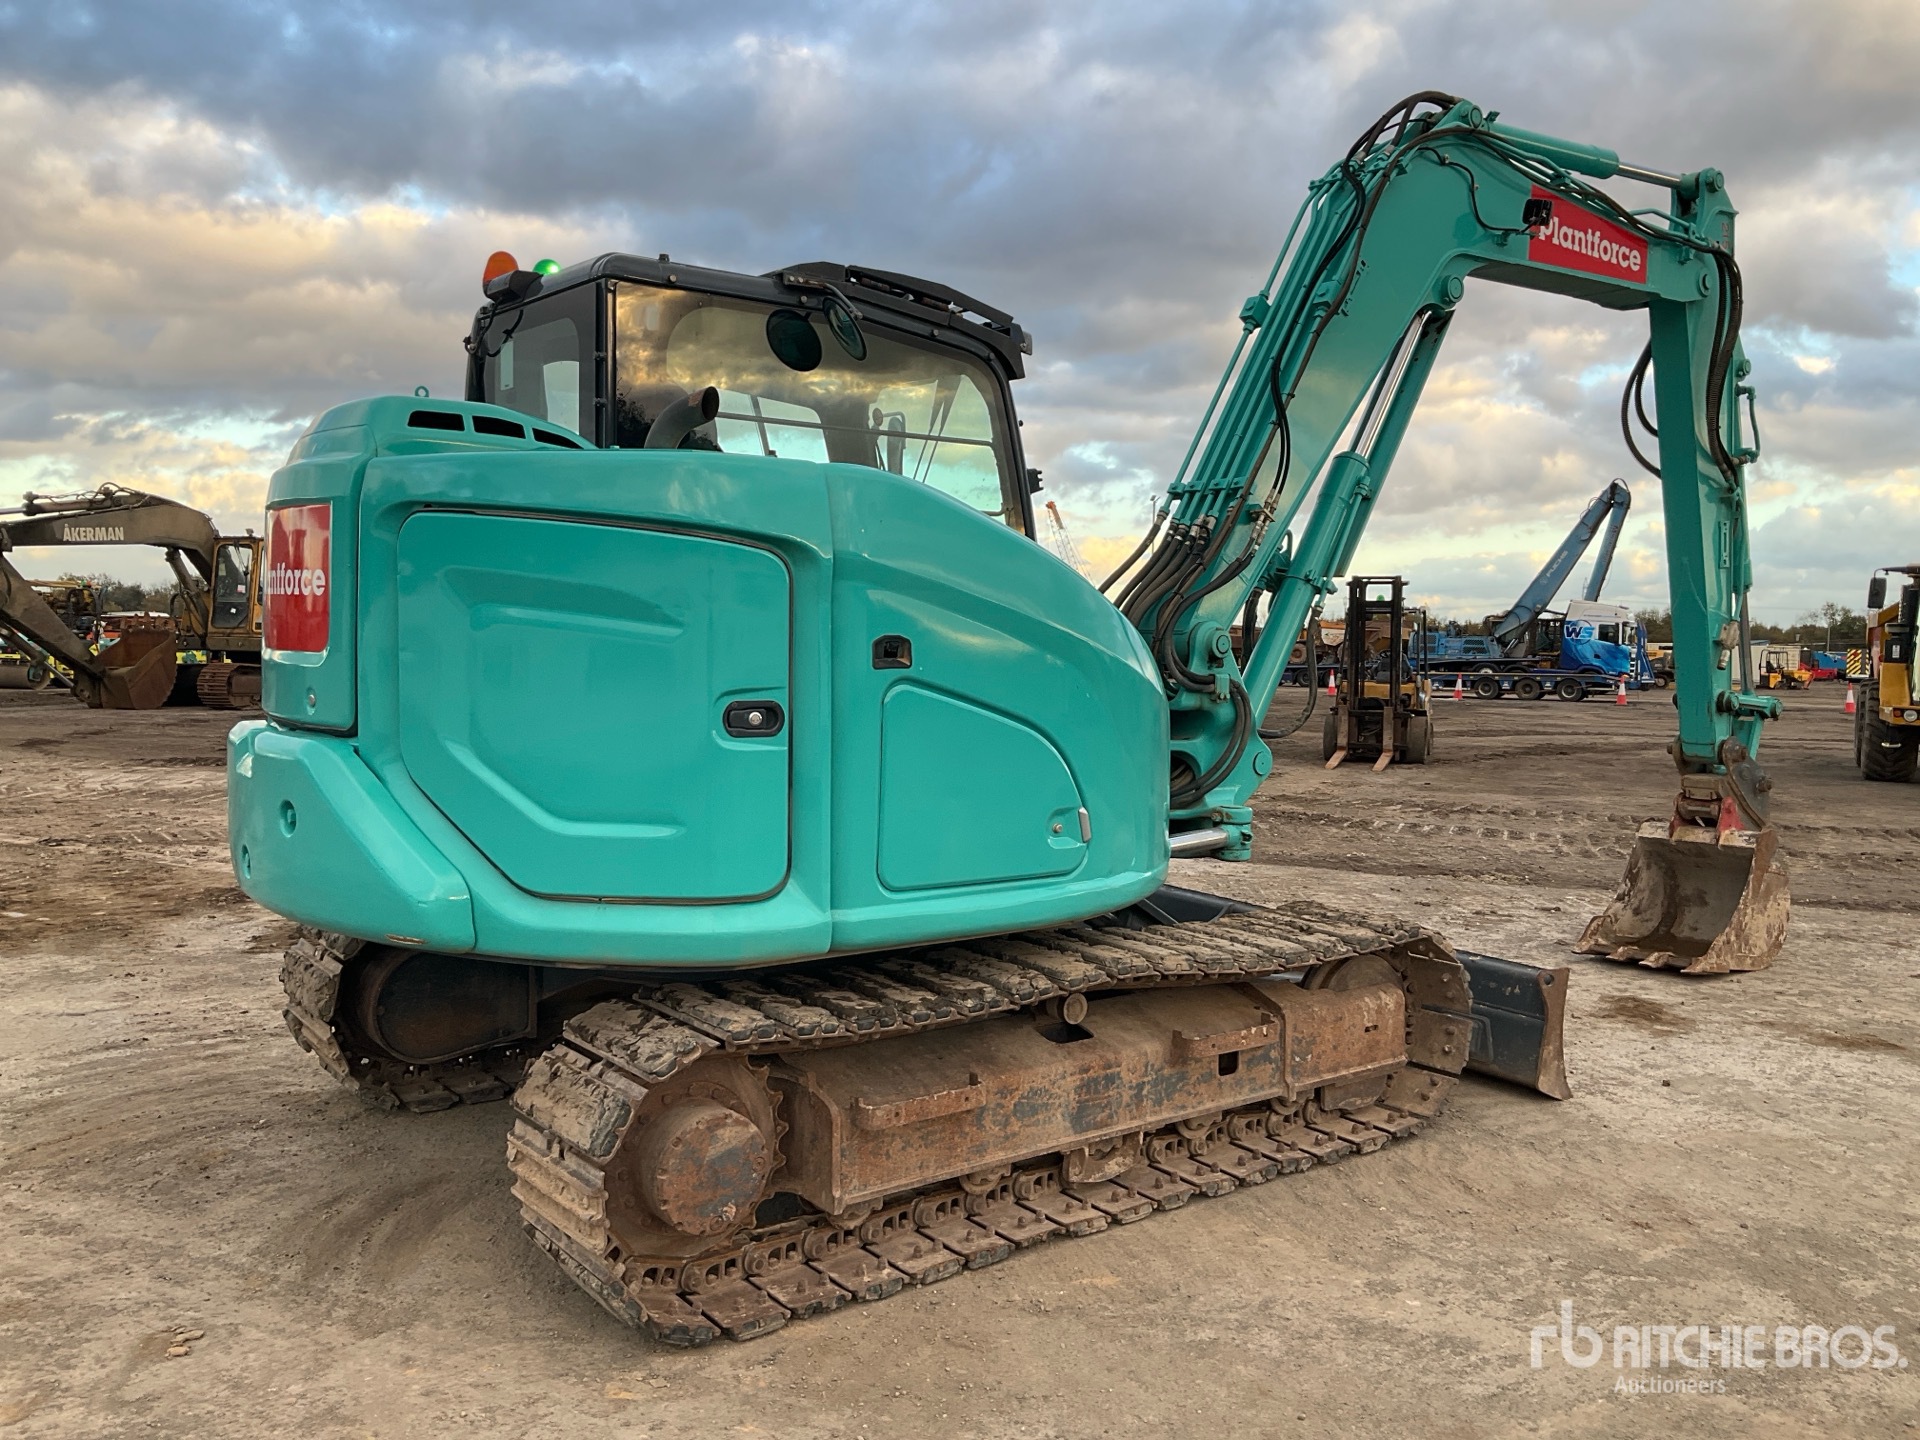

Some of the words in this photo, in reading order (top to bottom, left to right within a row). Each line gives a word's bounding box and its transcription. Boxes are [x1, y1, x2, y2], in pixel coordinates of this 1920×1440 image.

[63, 523, 124, 541] ÅKERMAN
[265, 562, 326, 596] ntforce
[1565, 625, 1595, 639] WS
